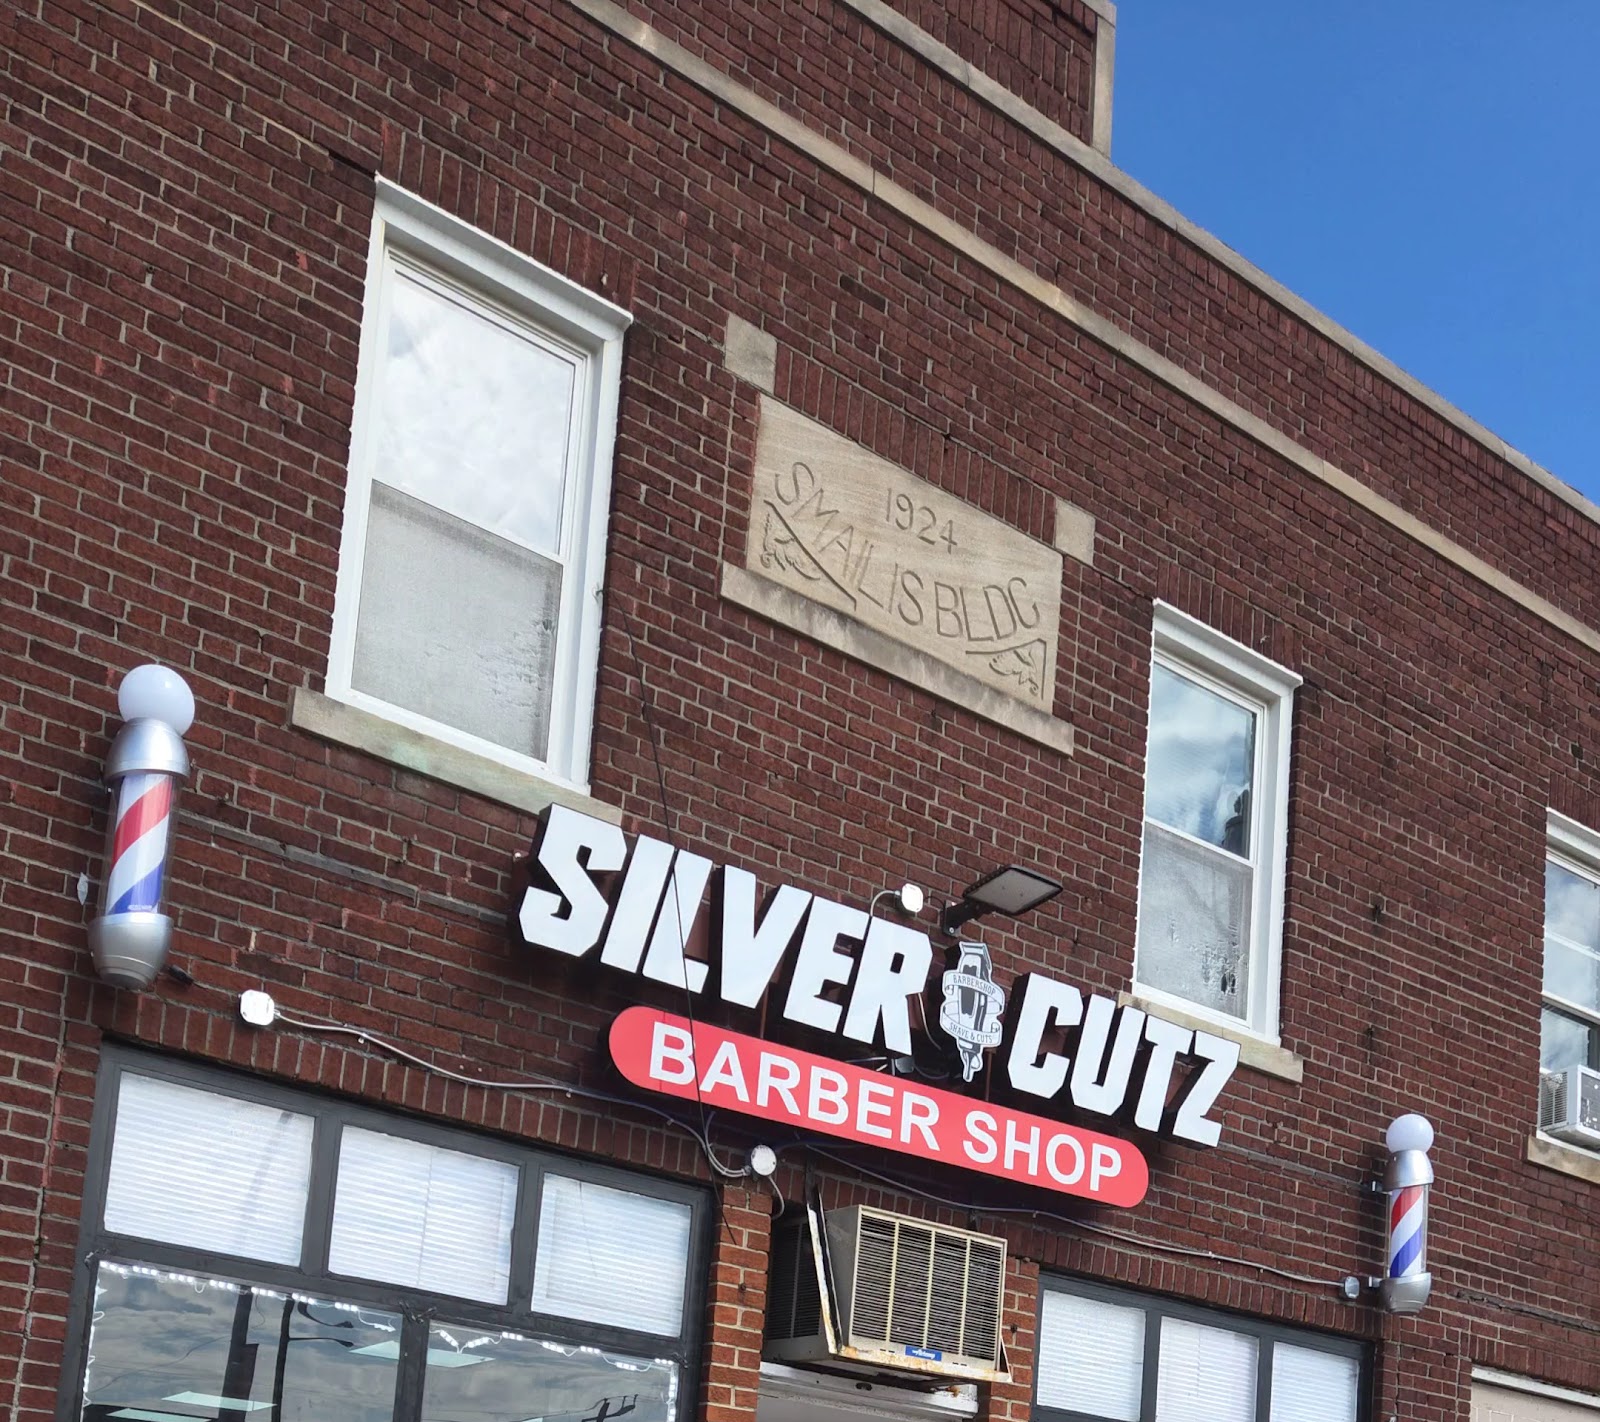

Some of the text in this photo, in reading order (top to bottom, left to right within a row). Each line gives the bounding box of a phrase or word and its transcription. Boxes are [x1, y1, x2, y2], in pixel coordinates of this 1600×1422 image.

[884, 488, 957, 554] 1924
[520, 803, 1241, 1147] SILVER CUTZ
[953, 974, 996, 996] BARBERSHOP
[949, 1022, 970, 1039] SHAVE
[977, 1033, 993, 1043] CUTS
[653, 1025, 1121, 1192] BARBER SHOP
